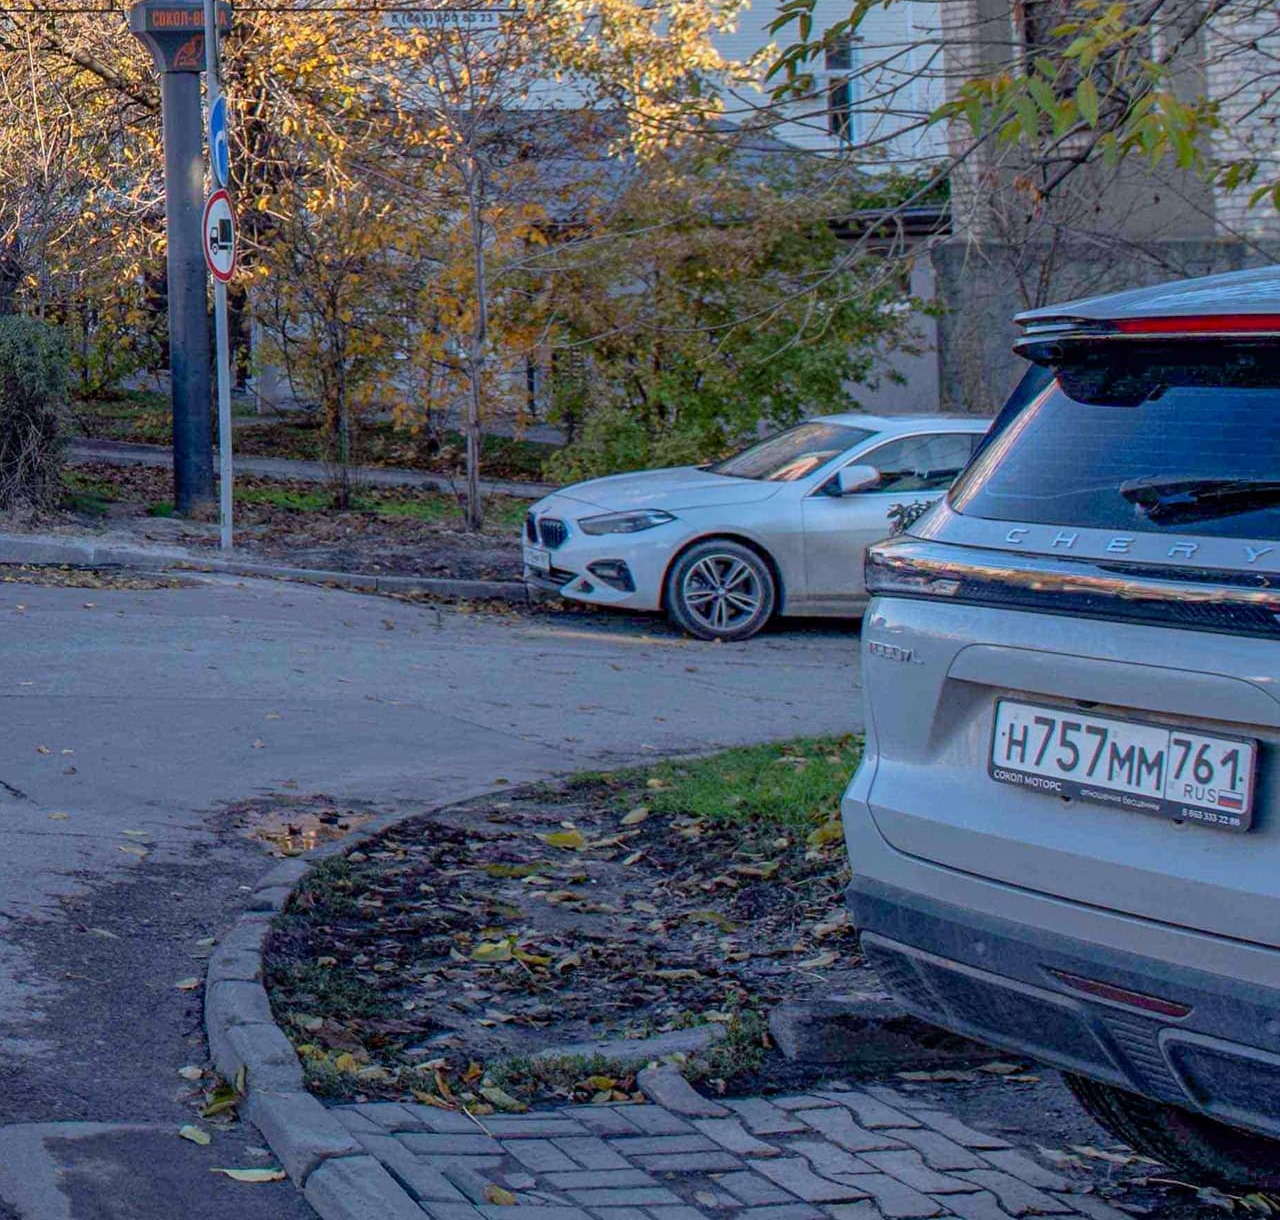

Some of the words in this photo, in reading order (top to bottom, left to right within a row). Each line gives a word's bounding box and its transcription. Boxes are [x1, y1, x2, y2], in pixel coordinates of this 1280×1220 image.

[1005, 528, 1273, 563] CHERY
[1172, 738, 1241, 790] 761
[993, 770, 1024, 785] СОКОЛ
[1024, 777, 1062, 792] МОТОРС
[1183, 783, 1216, 803] RUS
